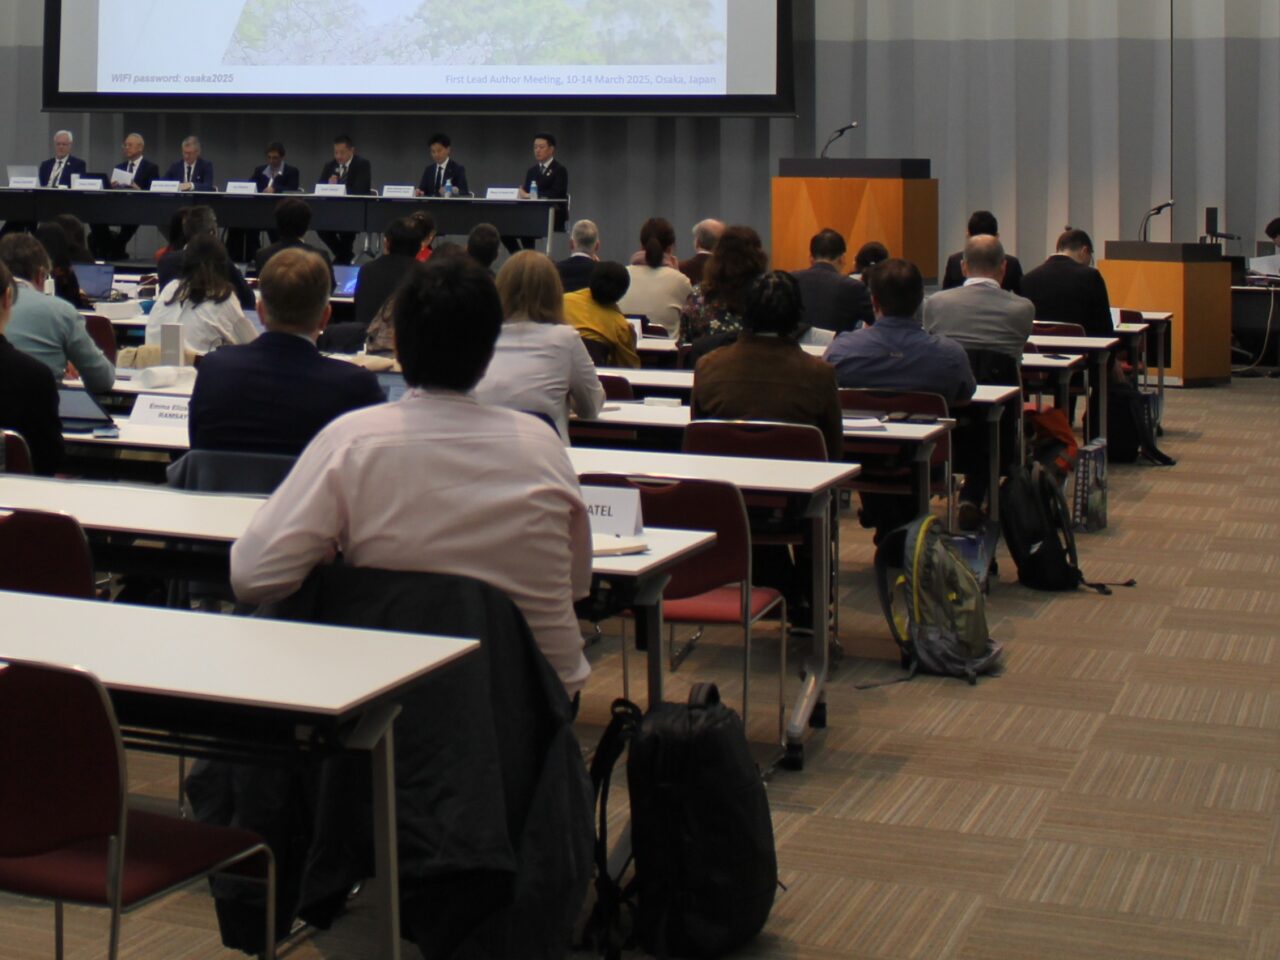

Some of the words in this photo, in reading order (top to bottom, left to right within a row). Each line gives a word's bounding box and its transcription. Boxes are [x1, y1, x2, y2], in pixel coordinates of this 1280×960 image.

[184, 73, 235, 83] osaka2025
[445, 75, 464, 85] First
[466, 74, 488, 85] Lead
[489, 74, 522, 85] Author
[566, 74, 593, 85] 10-14
[594, 74, 625, 85] March
[688, 74, 717, 86] Japan
[586, 504, 613, 517] ATEL
